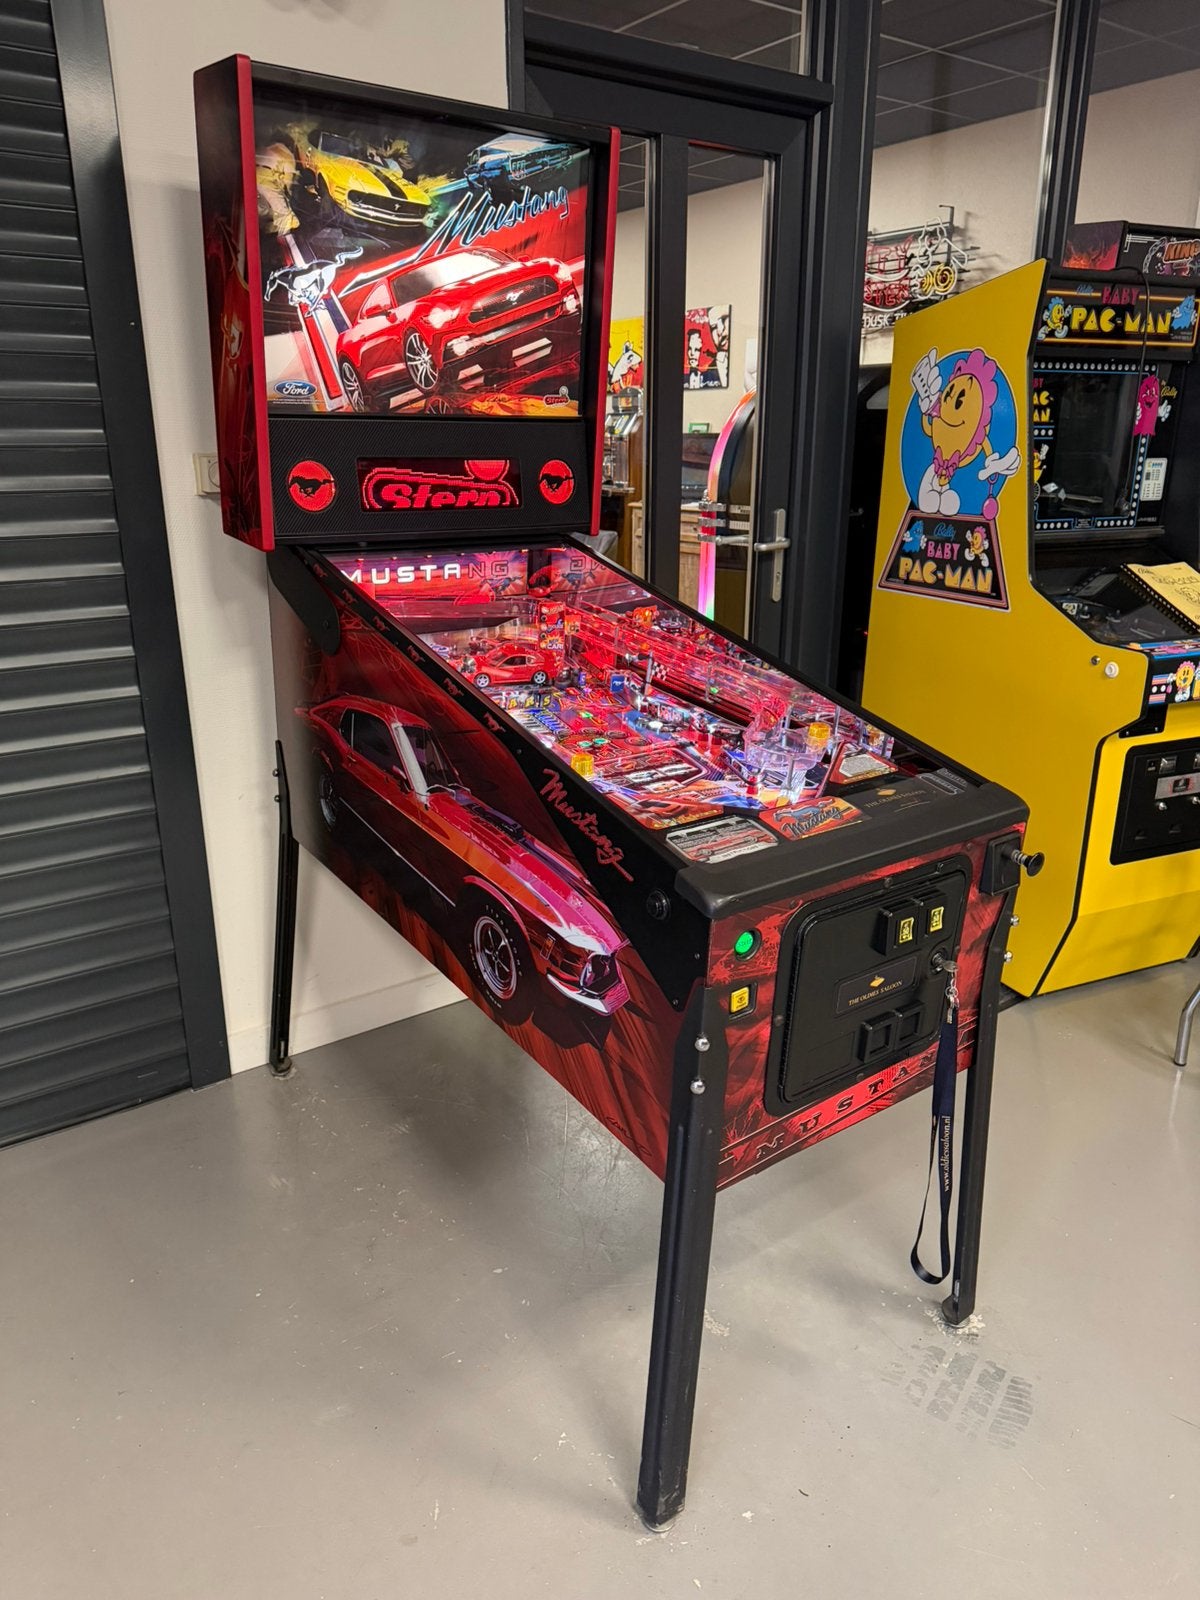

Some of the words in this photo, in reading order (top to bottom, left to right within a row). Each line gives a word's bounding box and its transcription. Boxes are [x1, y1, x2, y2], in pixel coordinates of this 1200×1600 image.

[415, 186, 568, 256] Mustang
[1102, 286, 1140, 305] BABY
[863, 314, 892, 328] DUSK
[1070, 306, 1172, 334] PAC-MAN
[283, 382, 309, 396] Ford
[1033, 391, 1054, 405] AC-
[1161, 386, 1178, 399] Bally
[1033, 408, 1051, 422] AN
[381, 483, 500, 508] Stern
[933, 522, 957, 541] Bally
[927, 541, 961, 561] BABY
[341, 560, 508, 585] MUSTANG
[898, 556, 993, 594] PAC-MAN
[541, 768, 634, 882] Mustang
[783, 808, 852, 836] Mustang
[848, 998, 859, 1006] THE
[860, 990, 879, 1002] OLDIES
[880, 979, 903, 994] SALOON
[756, 1052, 937, 1159] MUSTAN
